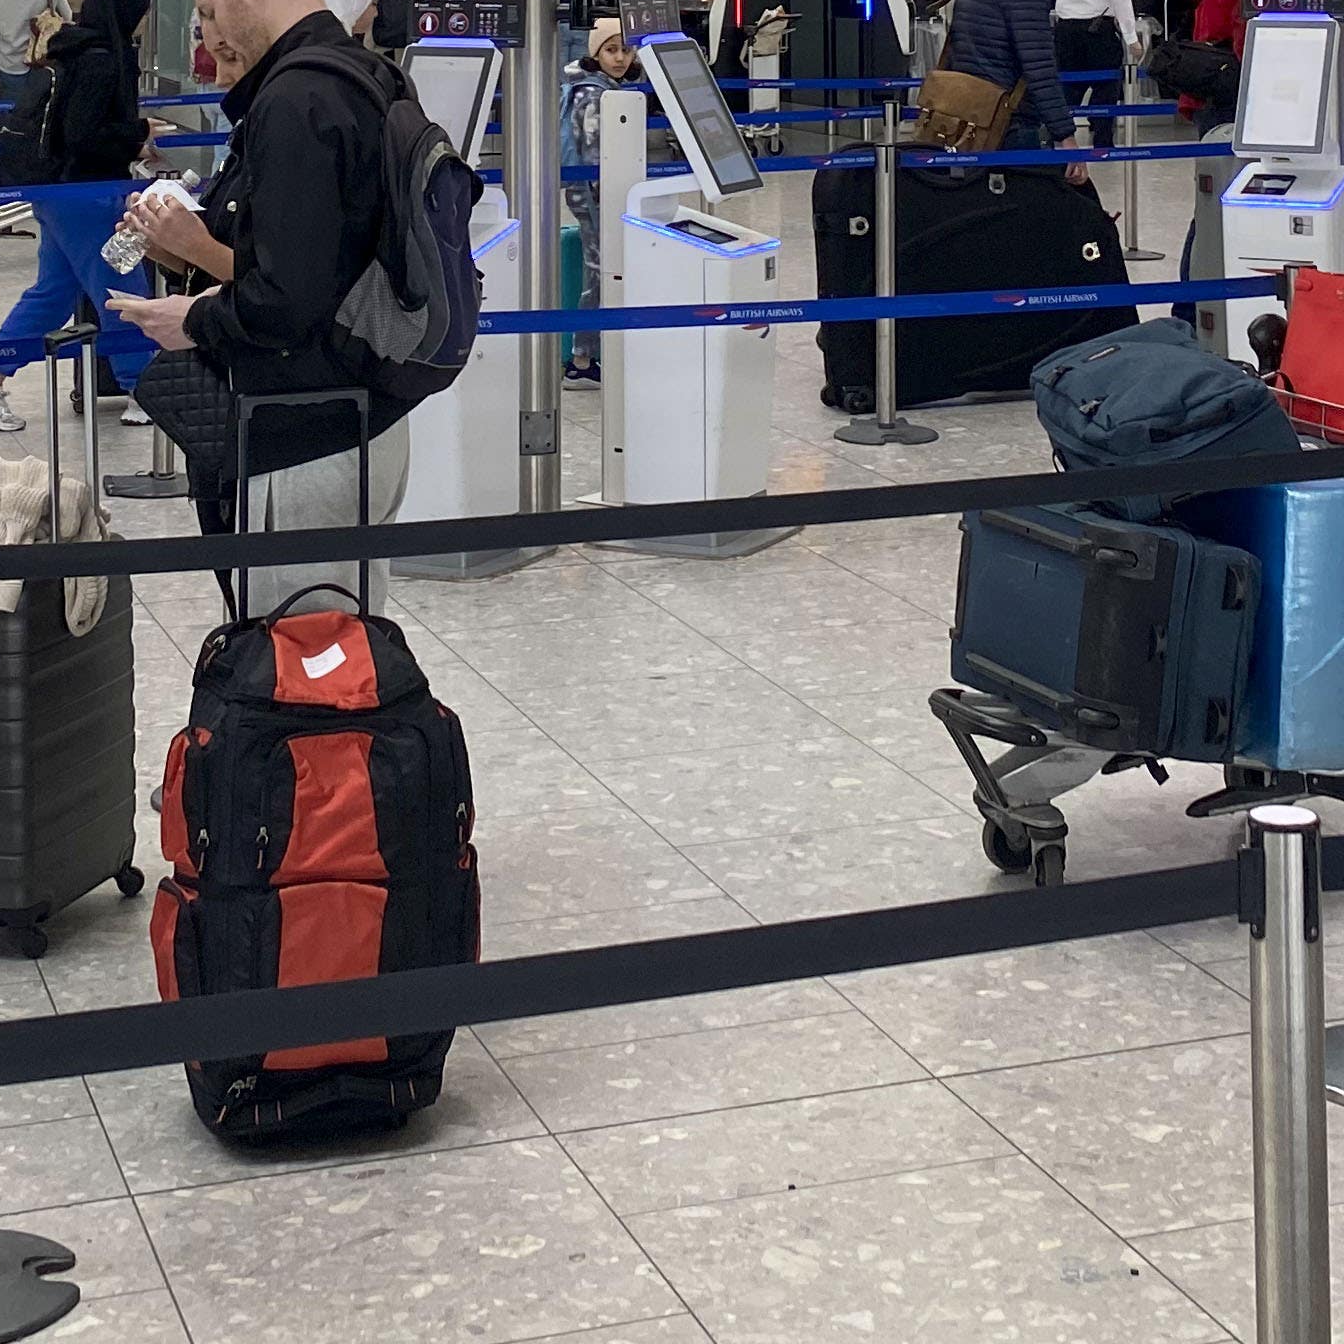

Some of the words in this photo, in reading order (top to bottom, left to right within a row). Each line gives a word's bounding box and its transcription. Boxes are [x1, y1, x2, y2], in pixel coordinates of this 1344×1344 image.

[1028, 296, 1062, 304] BRITISH
[1063, 293, 1098, 303] AIRWAYS
[730, 310, 765, 319] BRITISH
[766, 308, 803, 317] AIRWAYS
